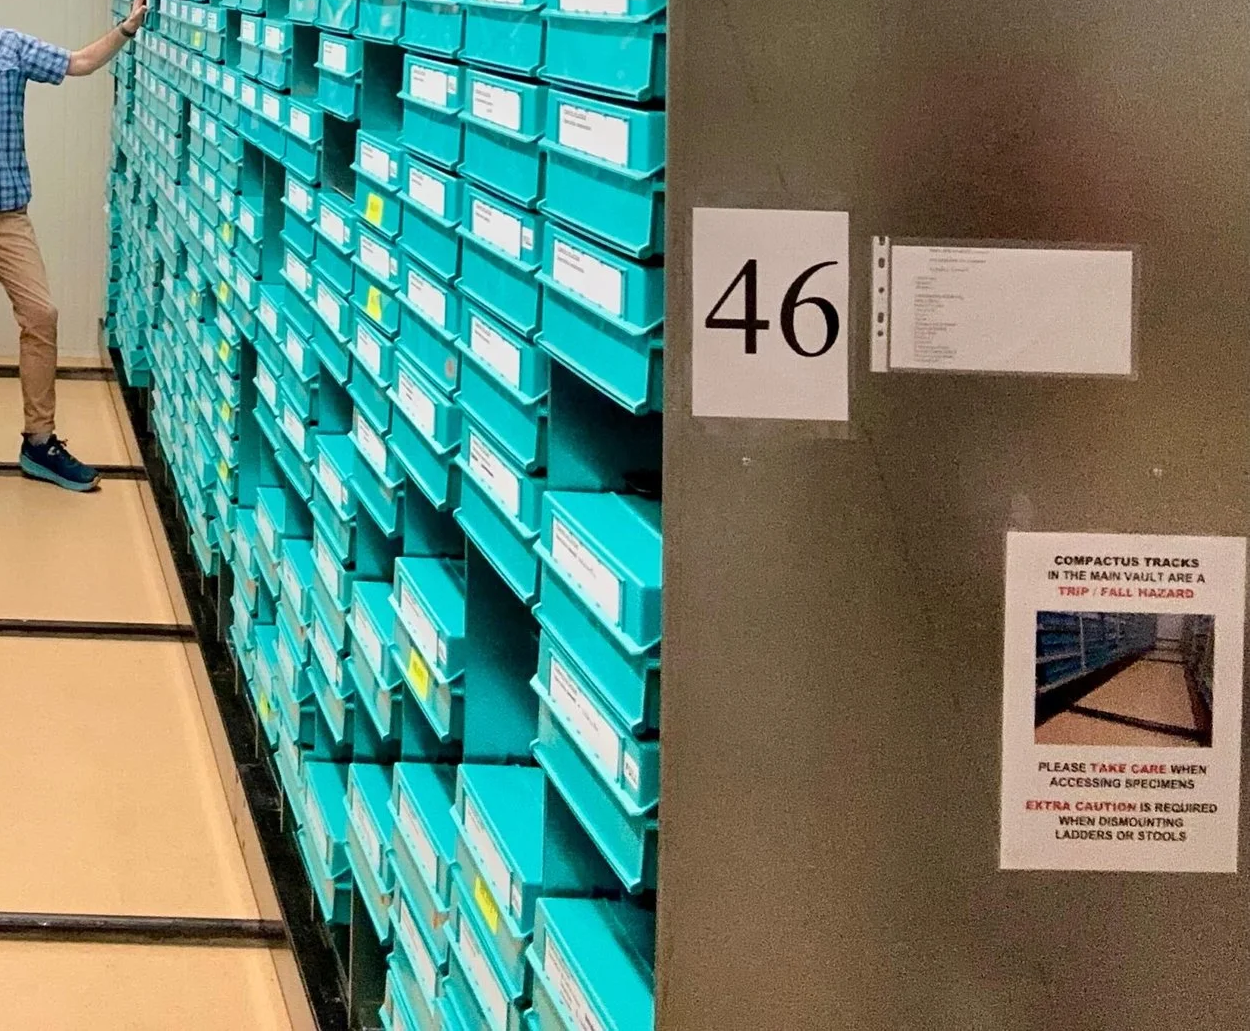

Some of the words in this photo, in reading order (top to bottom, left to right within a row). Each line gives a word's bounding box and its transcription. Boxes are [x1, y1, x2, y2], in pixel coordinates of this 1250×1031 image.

[705, 259, 840, 357] 46
[1054, 555, 1139, 567] COMPACTUS
[1143, 557, 1200, 568] TRACKS
[1048, 570, 1059, 580] IN
[1064, 570, 1087, 581] THE
[1090, 571, 1121, 581] MAIN
[1124, 571, 1164, 582] VAULT
[1167, 573, 1193, 583] ARE
[1196, 573, 1206, 583] A
[1058, 586, 1090, 597] TRIP
[1100, 587, 1134, 598] FALL
[1138, 588, 1195, 599] HAZARD
[1038, 761, 1087, 773] PLEASE
[1090, 763, 1127, 774] TAKE
[1130, 764, 1167, 774] CARE
[1170, 765, 1207, 775] WHEN
[1050, 777, 1121, 788] ACCESSING
[1125, 778, 1195, 790] SPECIMENS
[1025, 800, 1071, 811] EXTRA
[1075, 801, 1137, 812] CAUTION
[1140, 802, 1151, 812] IS
[1154, 803, 1218, 814] REQUIRED
[1059, 815, 1096, 826] WHEN
[1099, 816, 1184, 828] DISMOUNTING
[1055, 829, 1113, 840] LADDERS
[1116, 830, 1134, 841] OR
[1138, 831, 1187, 842] STOOLS
